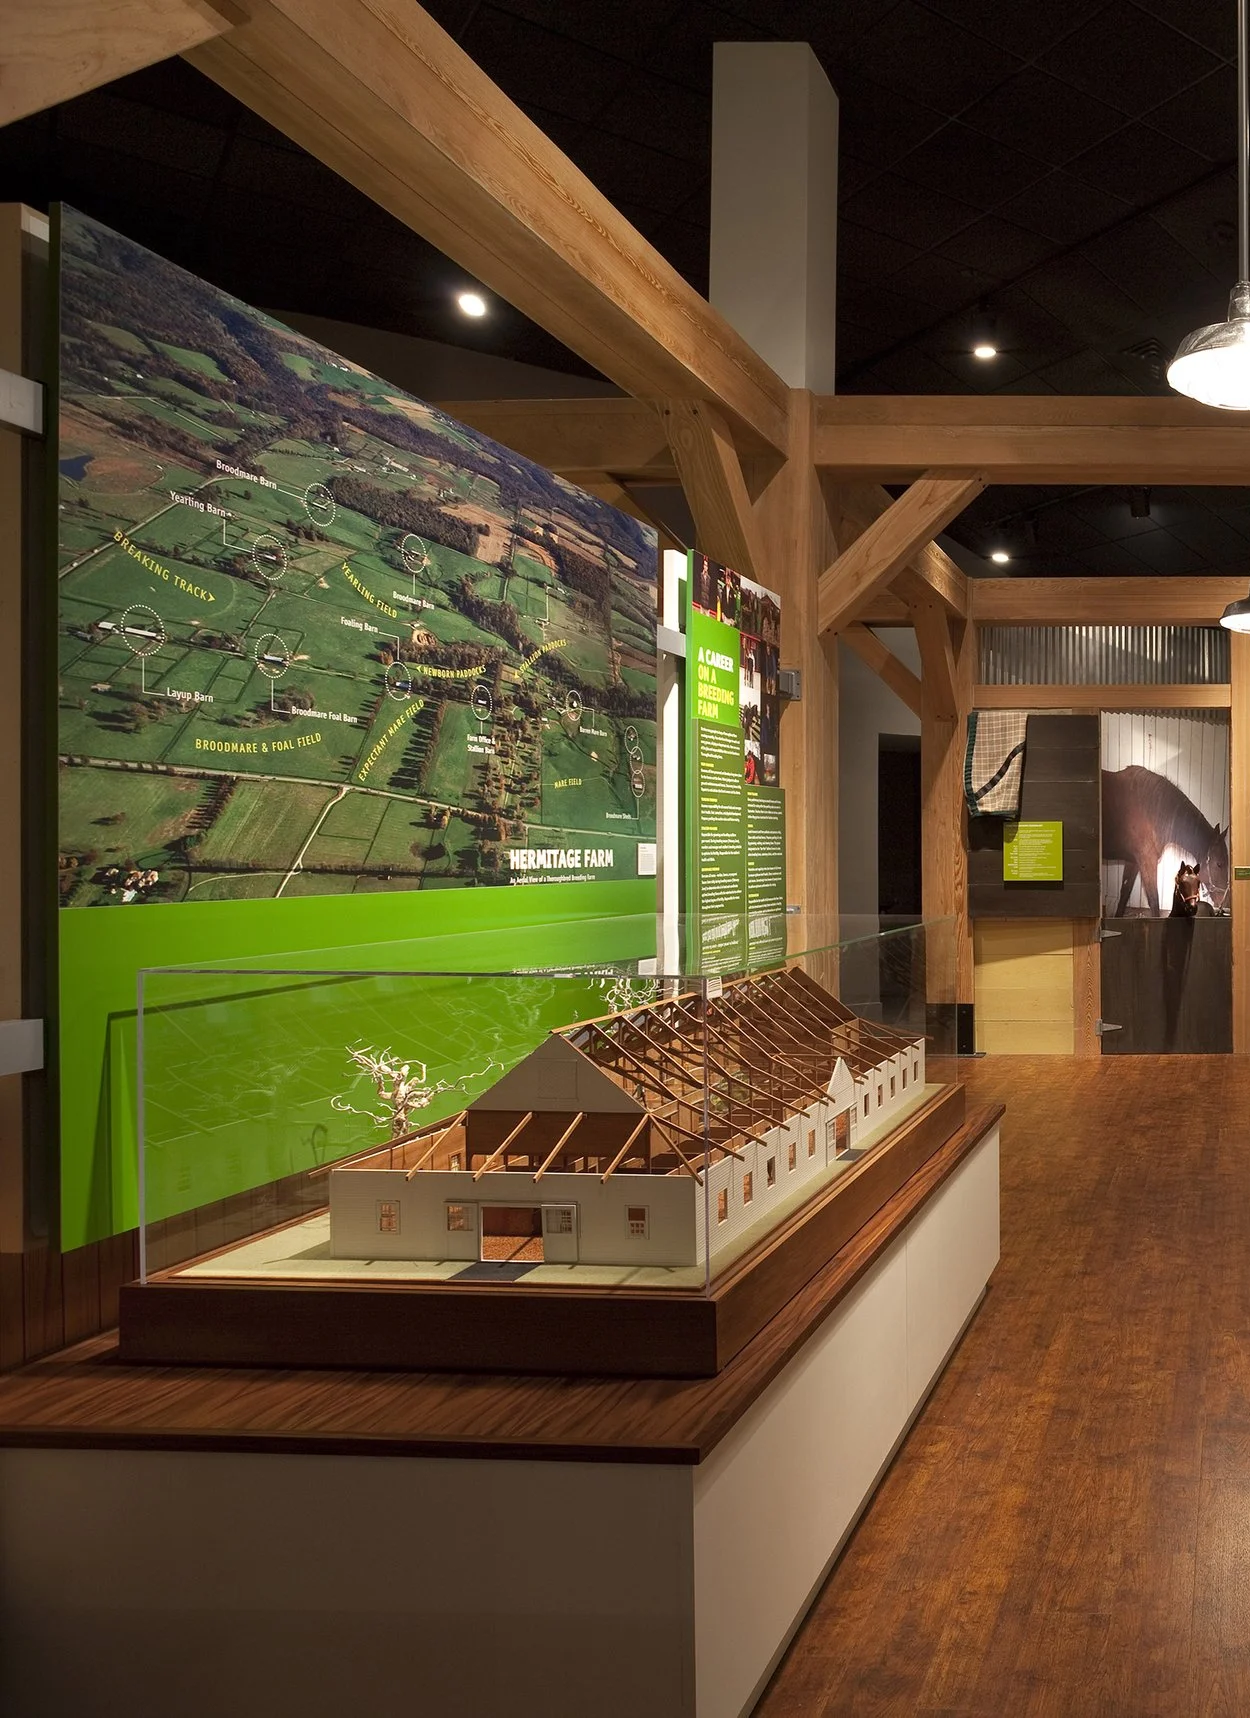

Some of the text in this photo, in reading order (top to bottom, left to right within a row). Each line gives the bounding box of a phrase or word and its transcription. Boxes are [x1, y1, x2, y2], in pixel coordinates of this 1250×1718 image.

[216, 459, 277, 490] Broodmare Barn
[207, 501, 226, 517] Barn
[113, 531, 208, 600] BREAKING TRACK
[342, 562, 398, 618] YEARLING FIELD
[365, 622, 378, 633] Barn
[698, 647, 734, 672] A CAREER
[423, 665, 486, 678] NEWBORN PADDOCKS
[698, 665, 717, 684] ON A
[167, 688, 213, 702] Layup Barn
[698, 682, 734, 706] BREEDING
[292, 706, 358, 723] Broodmare Foal Barn
[698, 699, 718, 719] FARM
[195, 732, 322, 753] BROODMARE & FOAL FIELD
[358, 699, 425, 782] EXPECTANT MARE FIELD
[510, 849, 614, 870] HERMITAGE FARM
